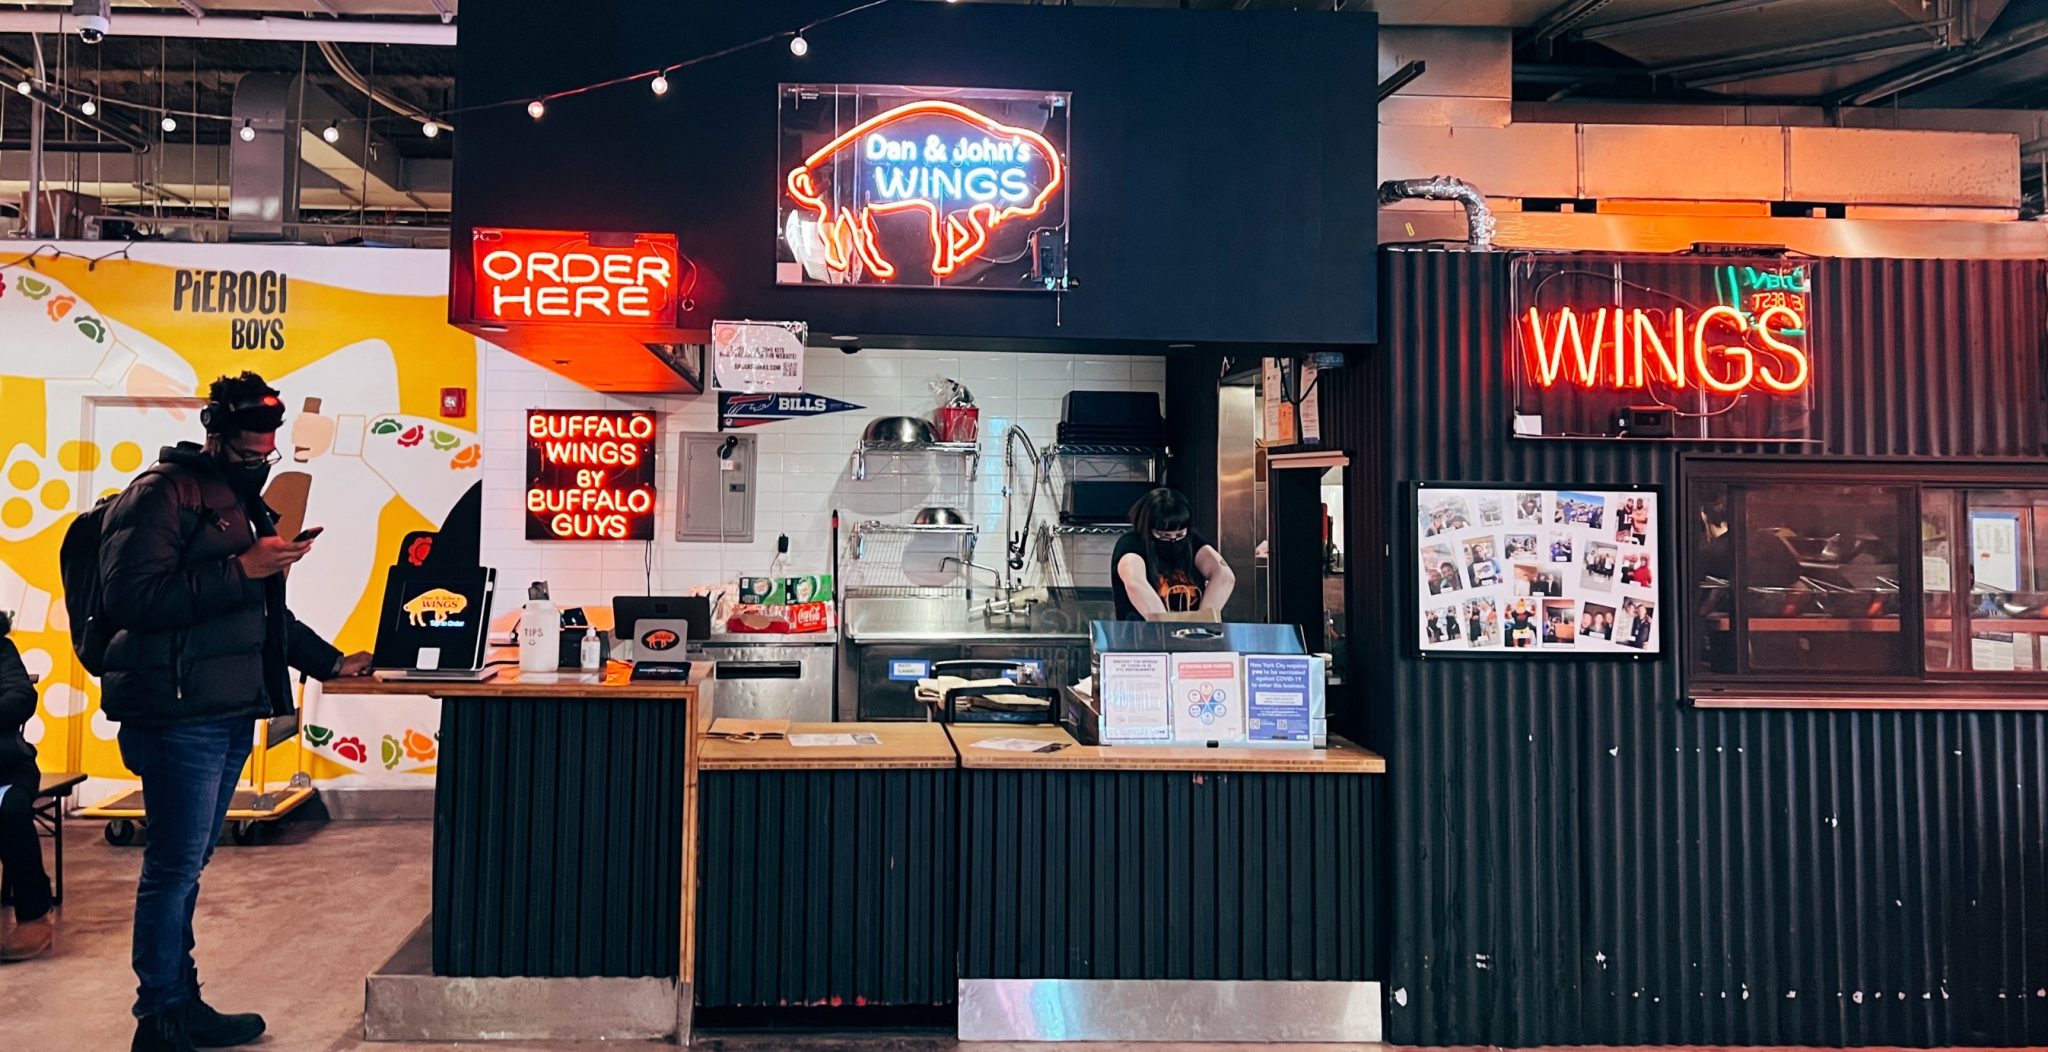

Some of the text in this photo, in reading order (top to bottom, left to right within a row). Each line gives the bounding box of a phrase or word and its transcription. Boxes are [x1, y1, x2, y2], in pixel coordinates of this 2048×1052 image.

[866, 133, 1031, 163] Dan & John's
[875, 166, 1029, 201] WINGS
[483, 251, 671, 288] ORDER
[493, 285, 651, 318] HERE
[231, 318, 284, 350] BOYS
[1529, 305, 1808, 392] WINGS
[778, 398, 826, 411] BILLS
[529, 415, 652, 438] BUFFALO
[545, 441, 637, 465] WINGS
[576, 469, 605, 488] BY
[527, 489, 650, 512] BUFFALO
[551, 513, 627, 538] GUYS
[422, 600, 458, 608] WINGS
[524, 628, 544, 637] TIPS
